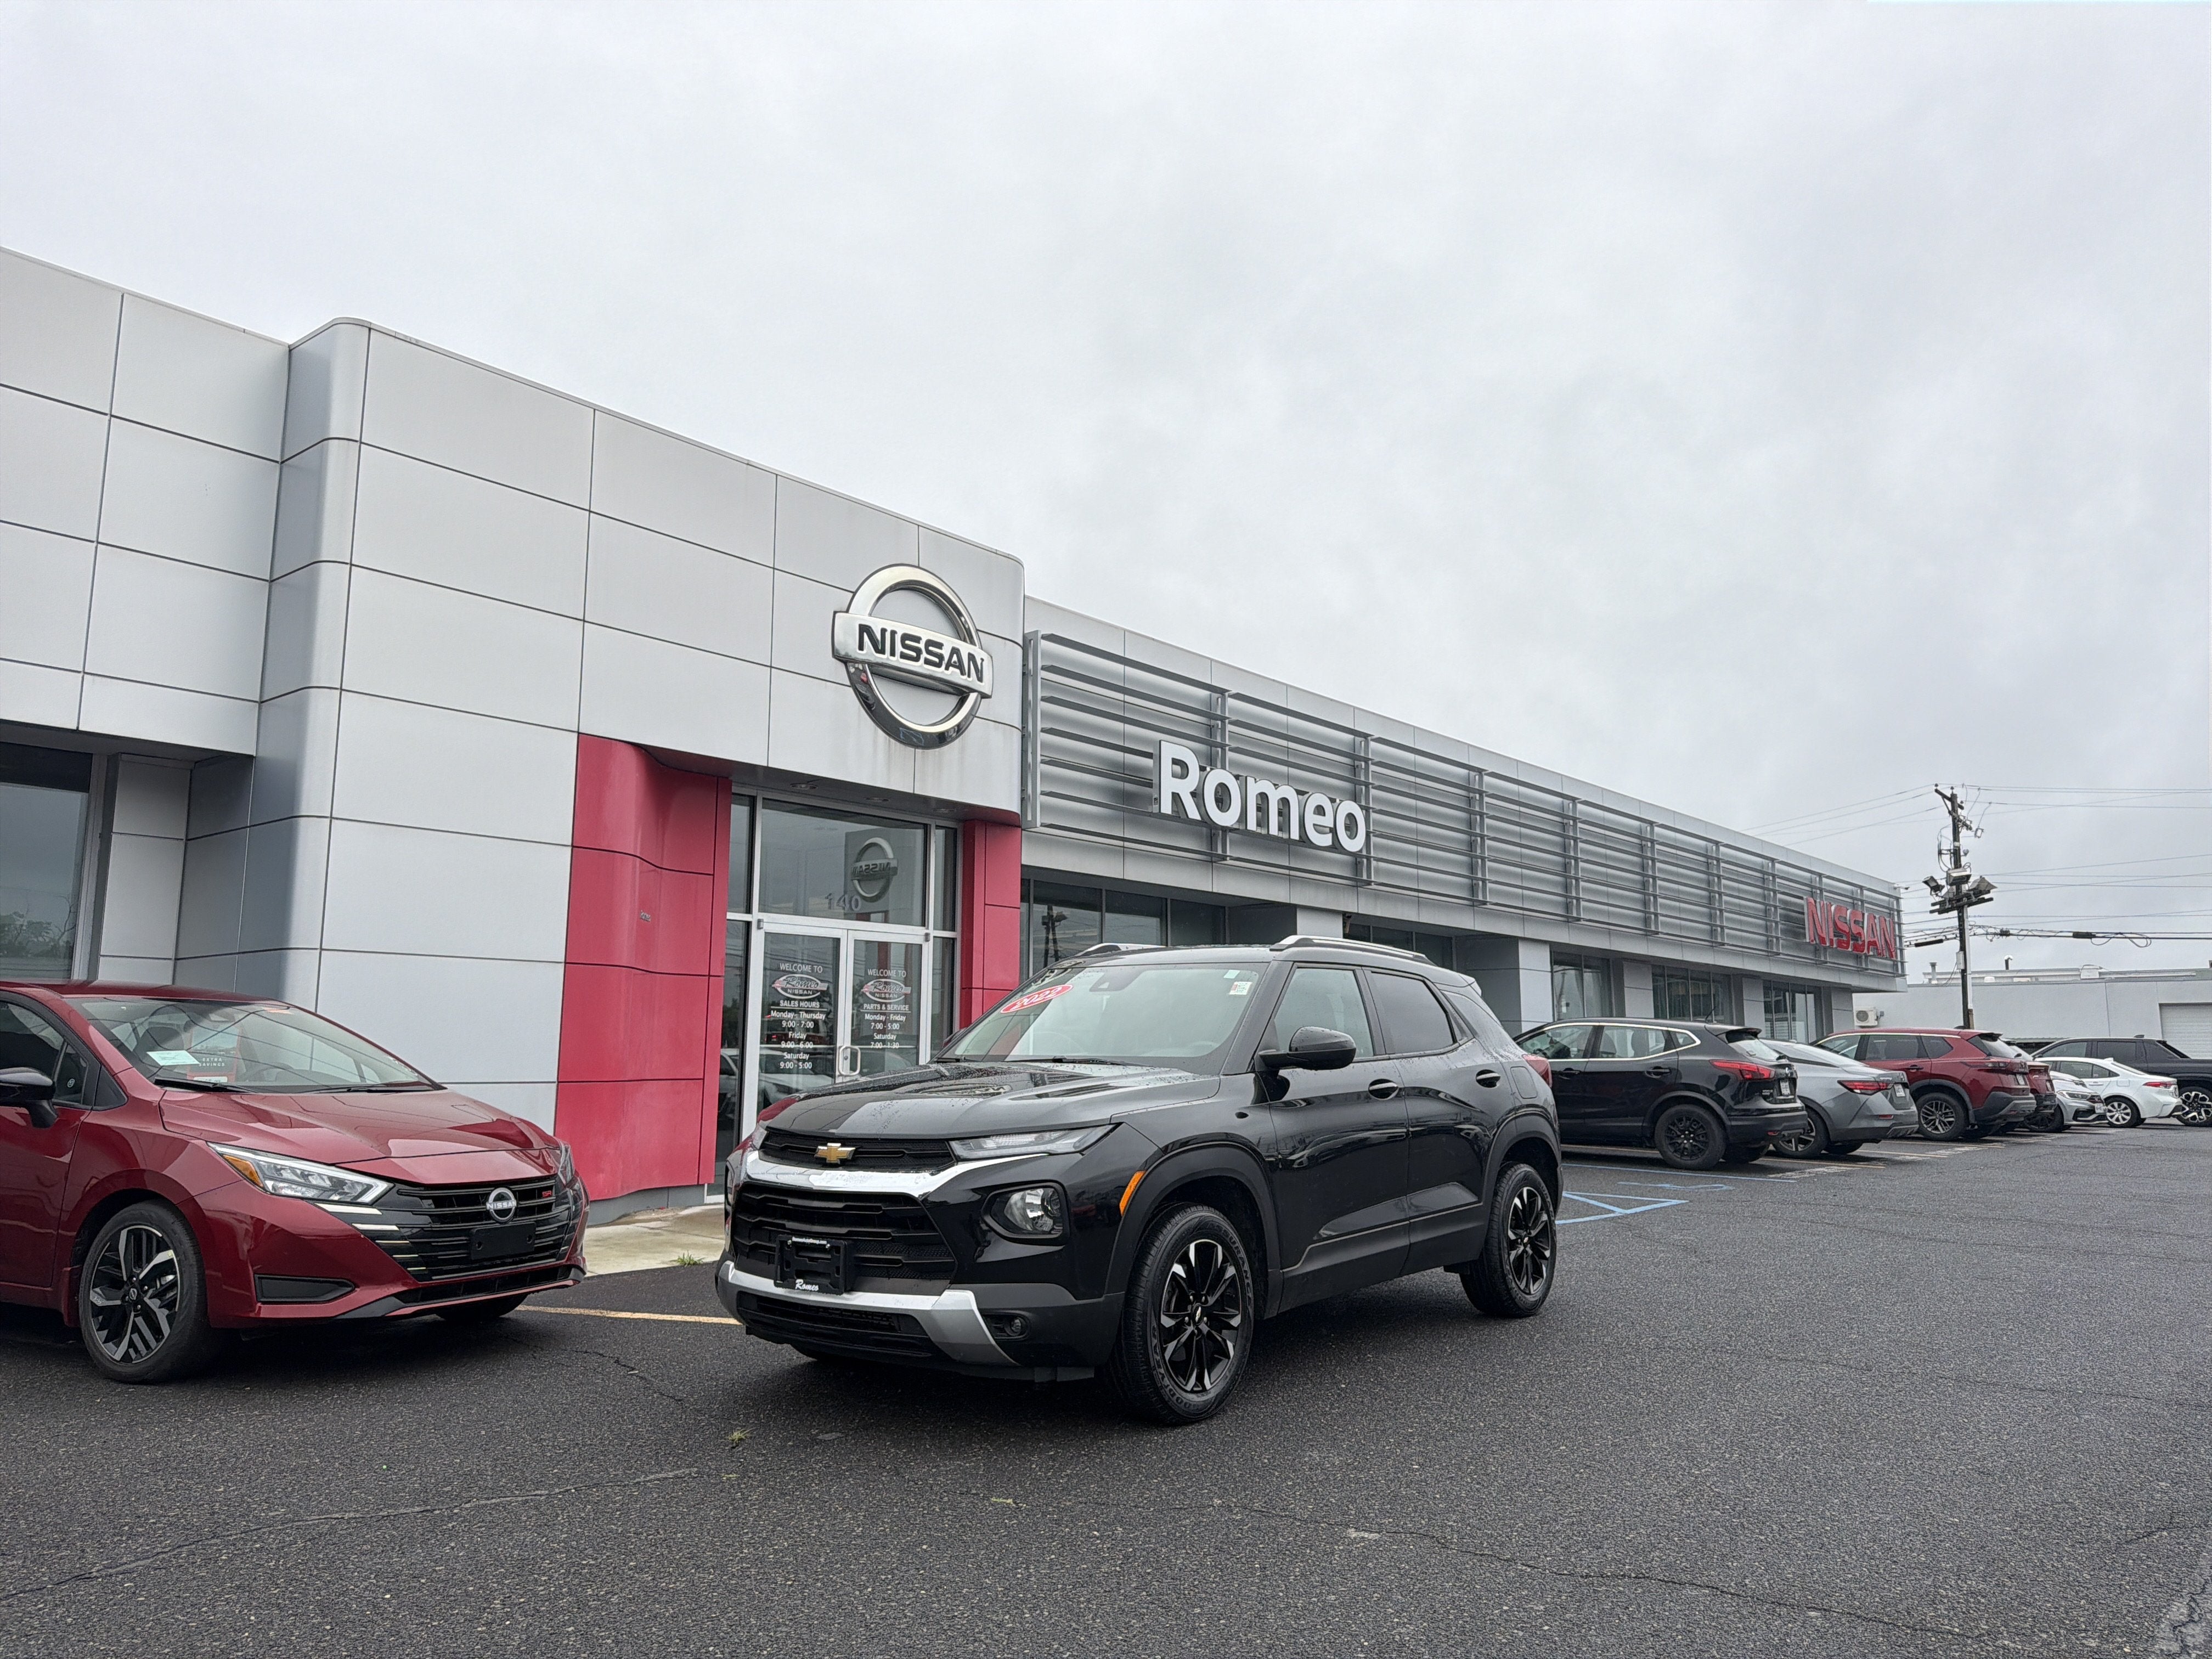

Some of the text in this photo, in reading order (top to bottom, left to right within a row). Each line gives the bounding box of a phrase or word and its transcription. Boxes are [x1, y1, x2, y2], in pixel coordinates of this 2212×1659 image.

[857, 623, 985, 683] NISSAN
[1159, 740, 1366, 853] Romeo
[825, 893, 862, 911] 140
[1804, 896, 1896, 960] NISSAN
[780, 963, 811, 972] WELCOME
[782, 976, 819, 988] Romeo
[1010, 987, 1063, 1011] 2022
[771, 1011, 794, 1019] Monday
[799, 1011, 826, 1020] Thursday
[865, 1013, 886, 1022] Monday
[890, 1014, 906, 1023] Friday
[789, 1031, 807, 1040] Friday
[873, 1032, 896, 1041] Saturday
[487, 1200, 516, 1210] NISSAN
[795, 1279, 819, 1291] Romeo
